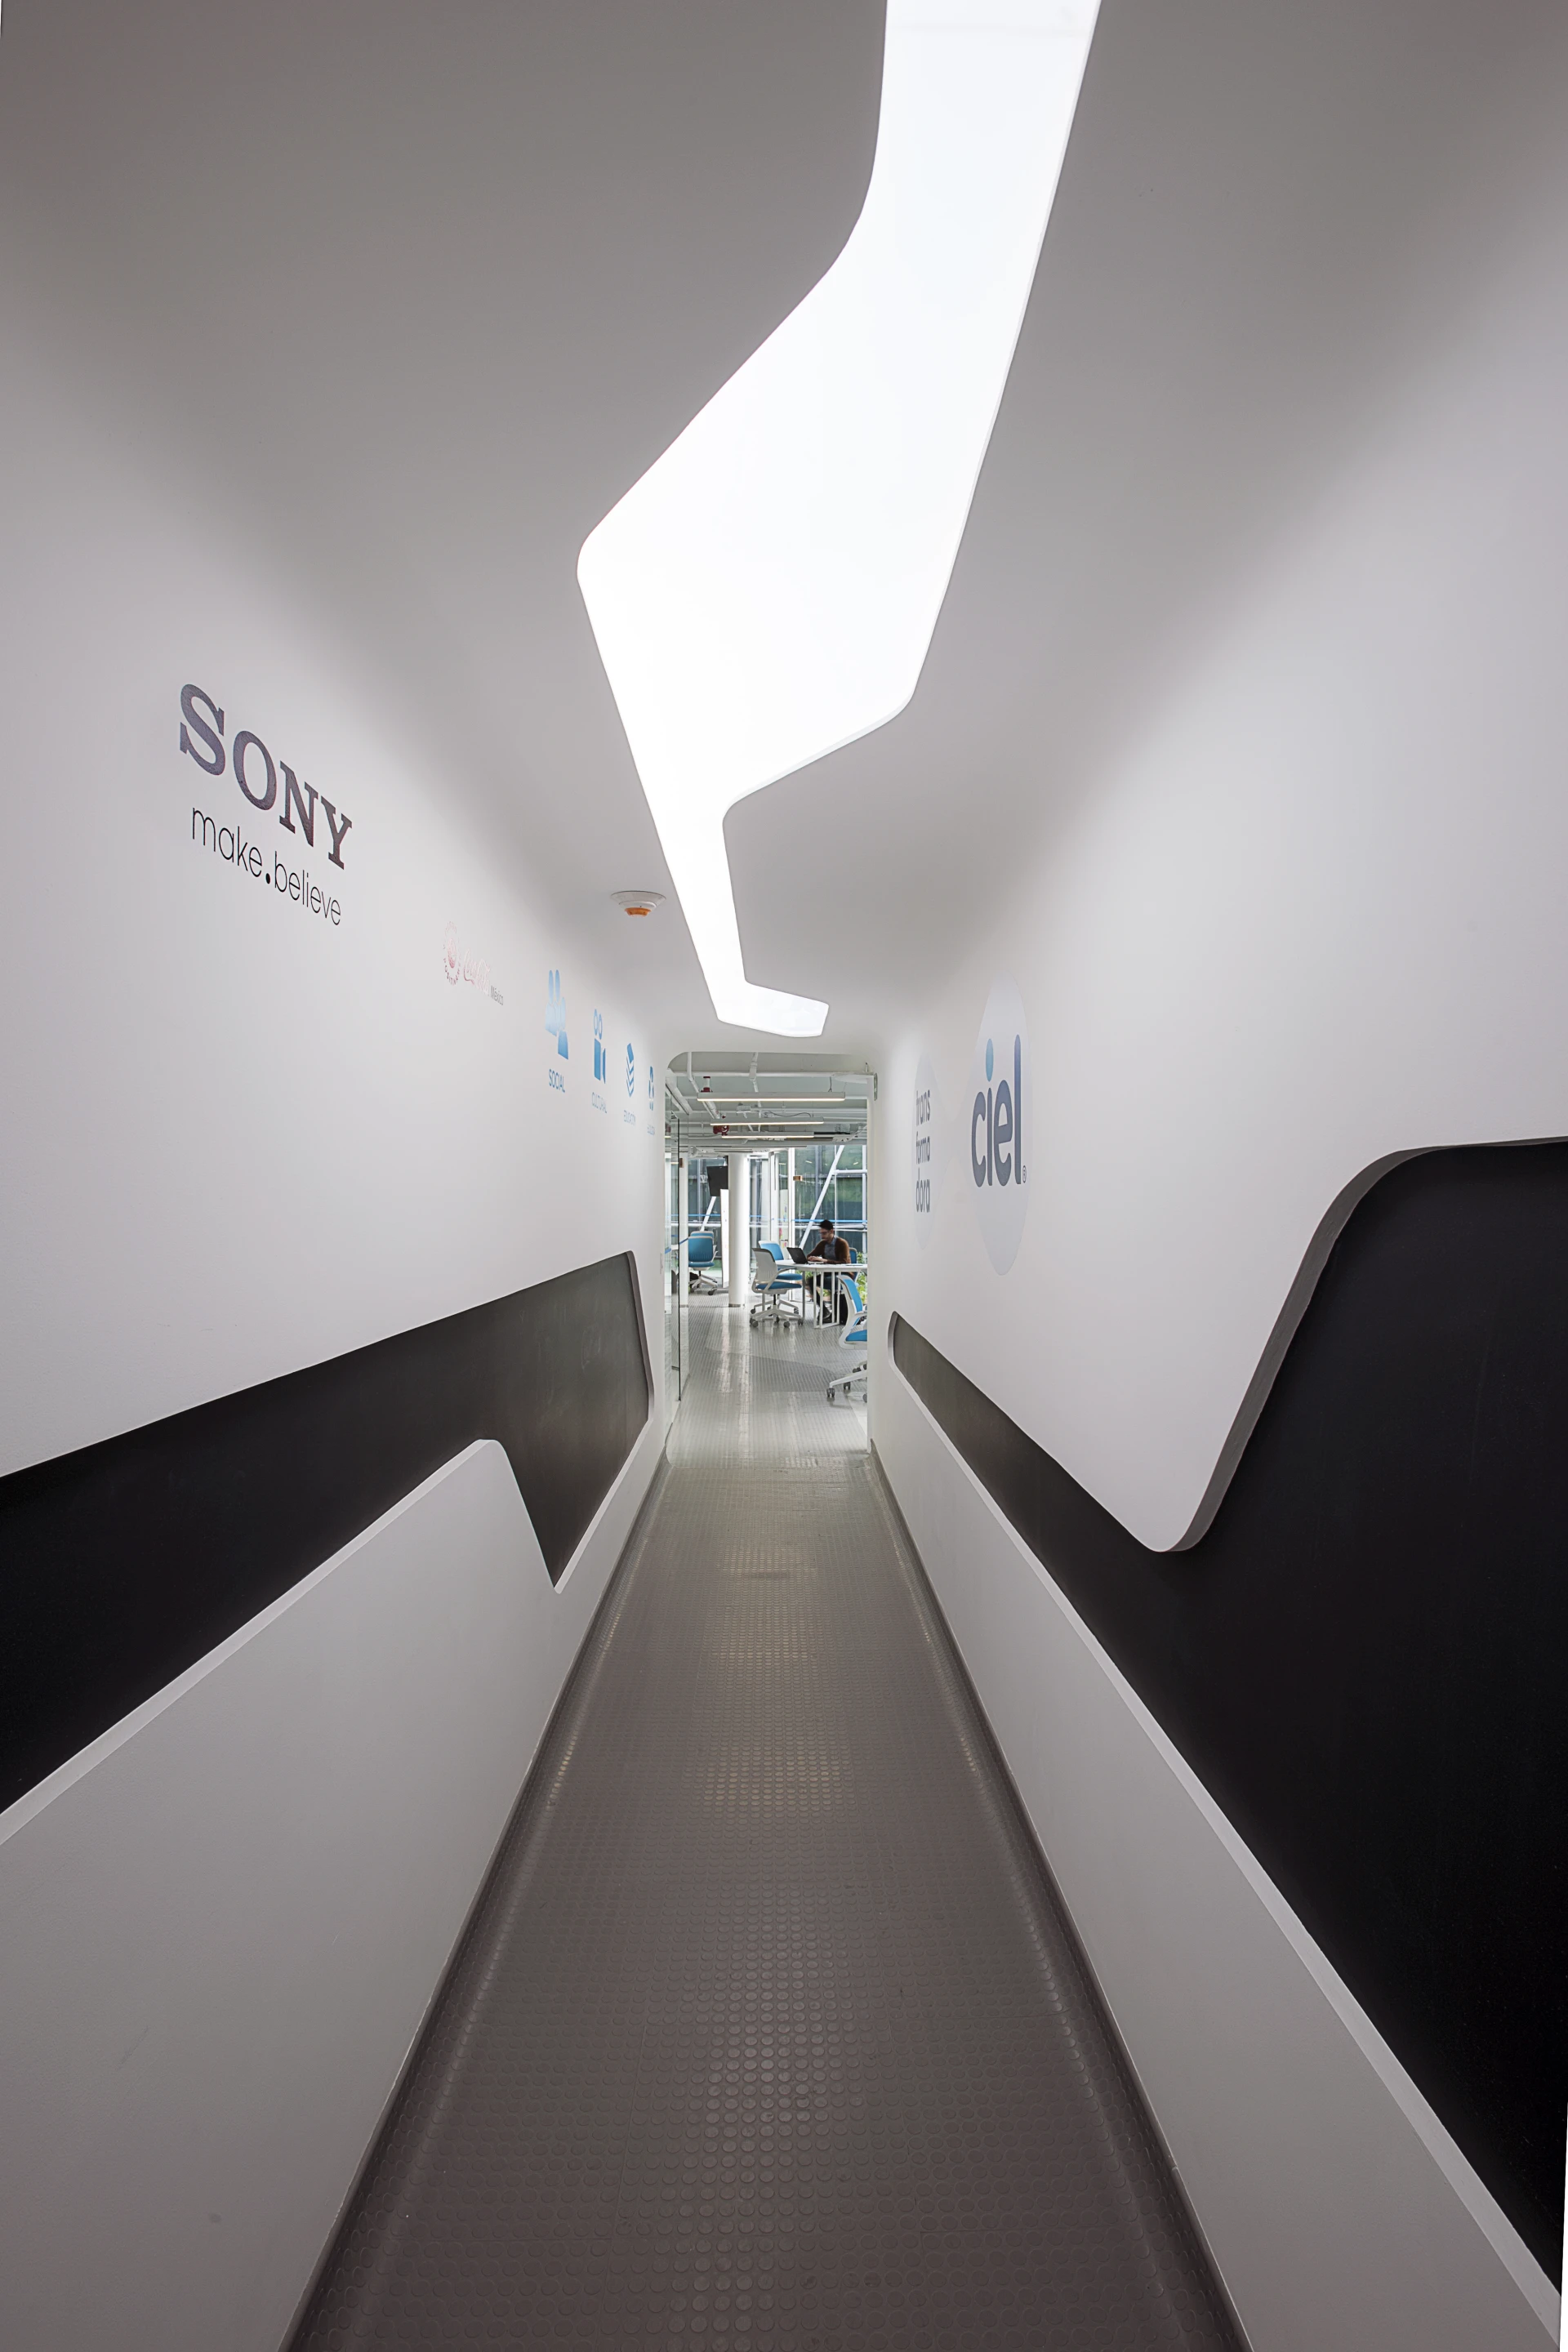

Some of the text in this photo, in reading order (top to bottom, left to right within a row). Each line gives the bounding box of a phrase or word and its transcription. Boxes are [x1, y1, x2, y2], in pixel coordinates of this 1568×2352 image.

[180, 684, 352, 870] SONY
[192, 807, 341, 925] make.believe
[915, 1089, 931, 1126] trans
[915, 1131, 930, 1164] forma
[971, 1034, 1022, 1187] ciel
[915, 1167, 930, 1213] dora
